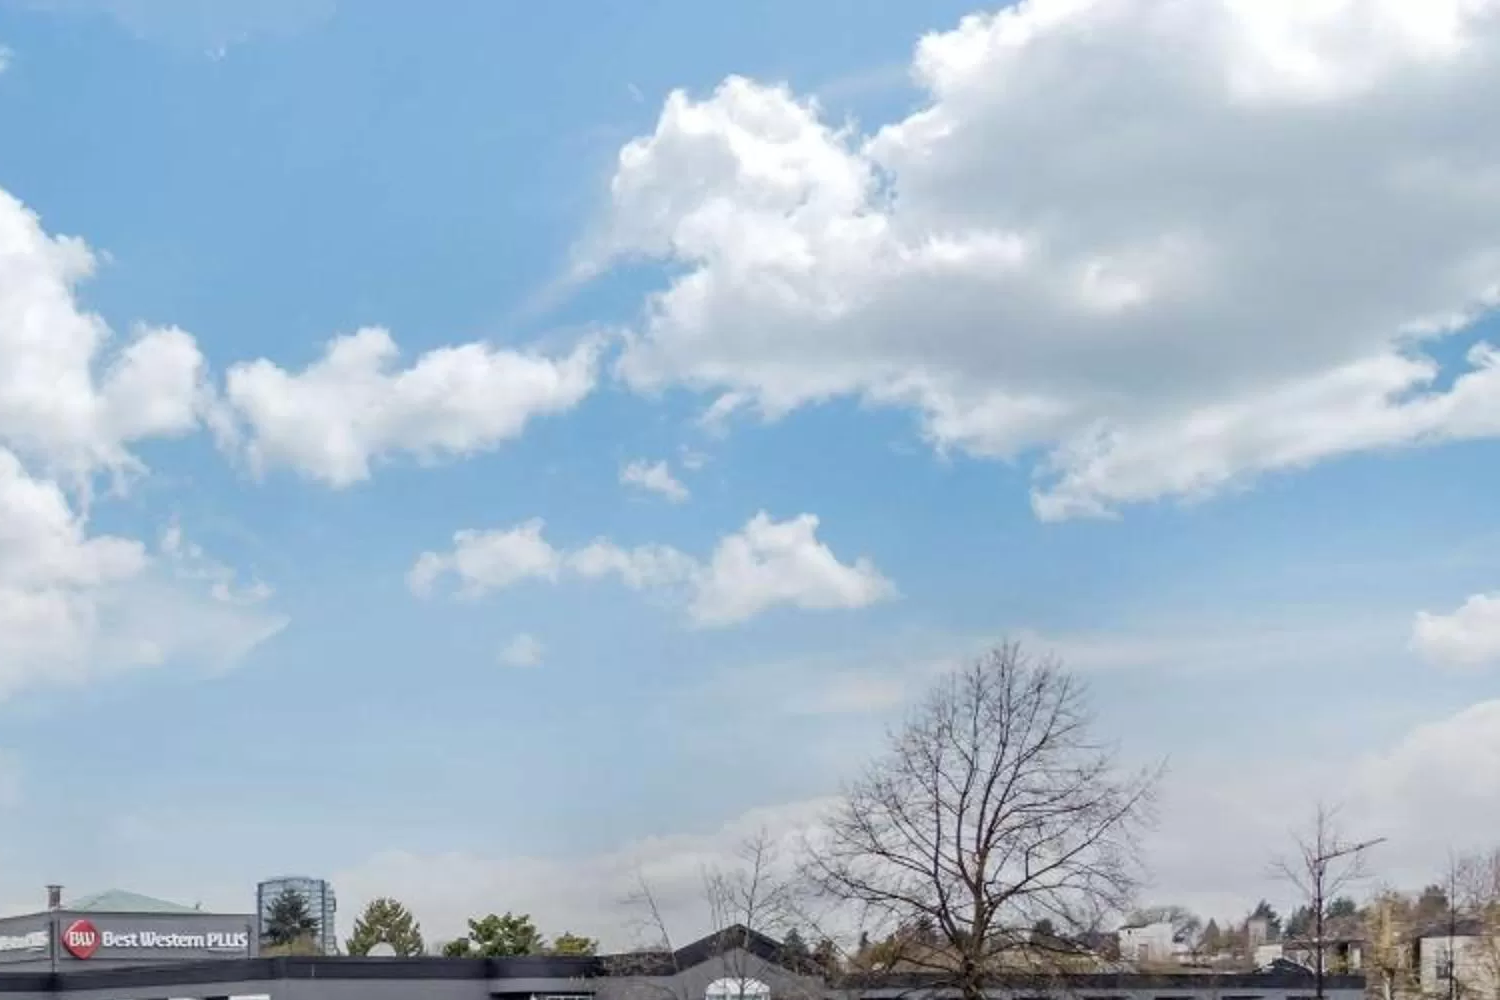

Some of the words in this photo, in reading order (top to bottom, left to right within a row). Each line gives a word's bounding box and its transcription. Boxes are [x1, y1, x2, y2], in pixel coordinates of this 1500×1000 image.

[69, 932, 95, 947] BW
[102, 931, 138, 948] Best
[140, 931, 204, 948] Western
[207, 931, 248, 951] PLUS
